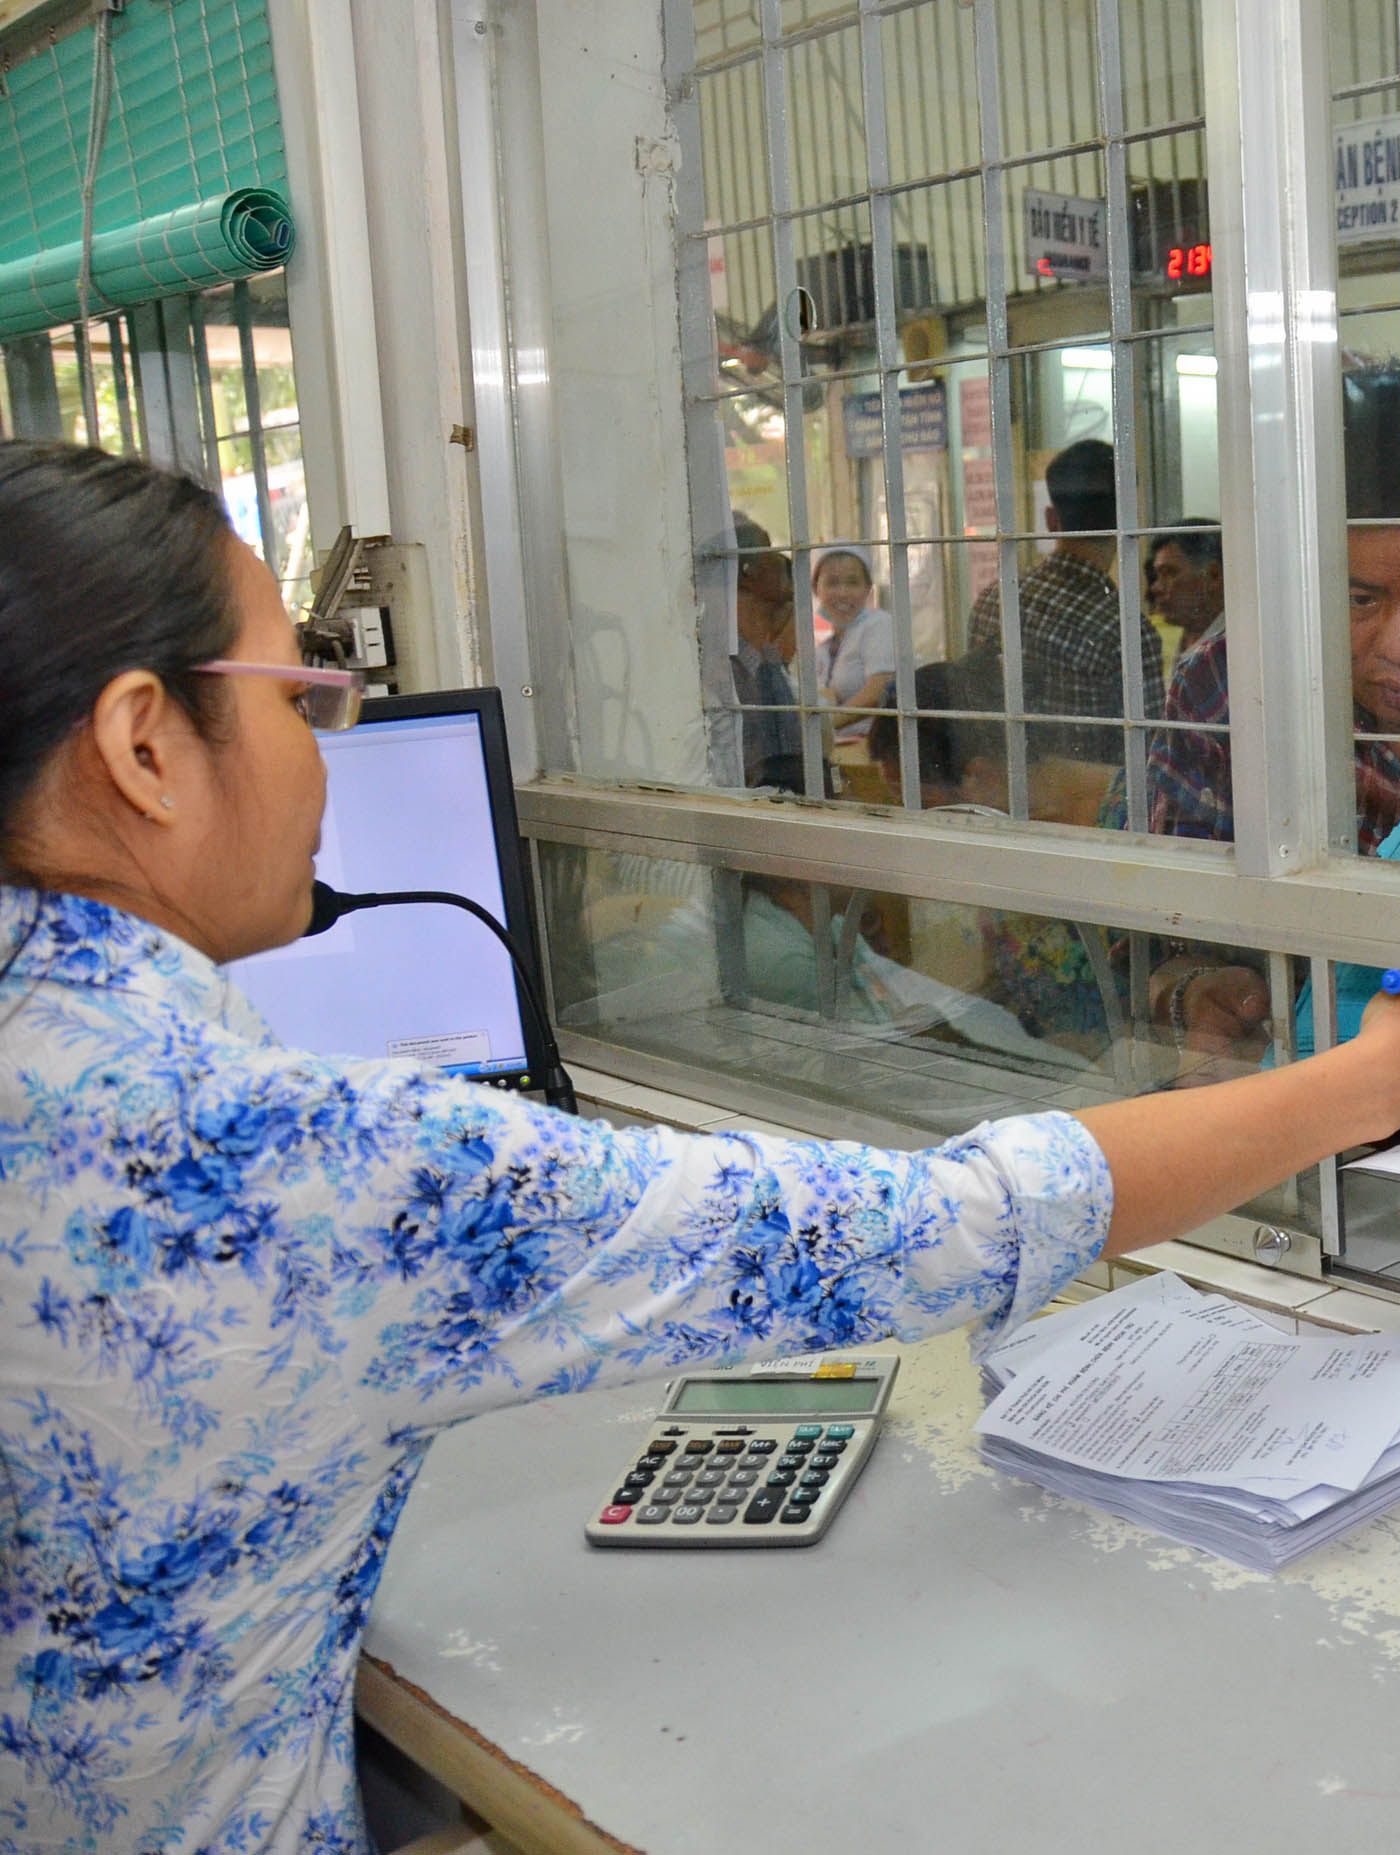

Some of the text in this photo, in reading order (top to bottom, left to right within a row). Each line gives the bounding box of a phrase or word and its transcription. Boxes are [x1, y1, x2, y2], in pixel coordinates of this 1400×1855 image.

[1337, 199, 1399, 230] CEPTION 2
[682, 1456, 695, 1464] 7
[713, 1456, 726, 1464] 8
[745, 1456, 758, 1464] 9
[671, 1472, 683, 1480] 4
[703, 1472, 715, 1480] 5
[735, 1472, 746, 1480] 6
[691, 1488, 704, 1498] 2
[724, 1488, 737, 1497] 3
[608, 1507, 622, 1516] C
[645, 1507, 658, 1516] 0
[676, 1506, 697, 1516] 00
